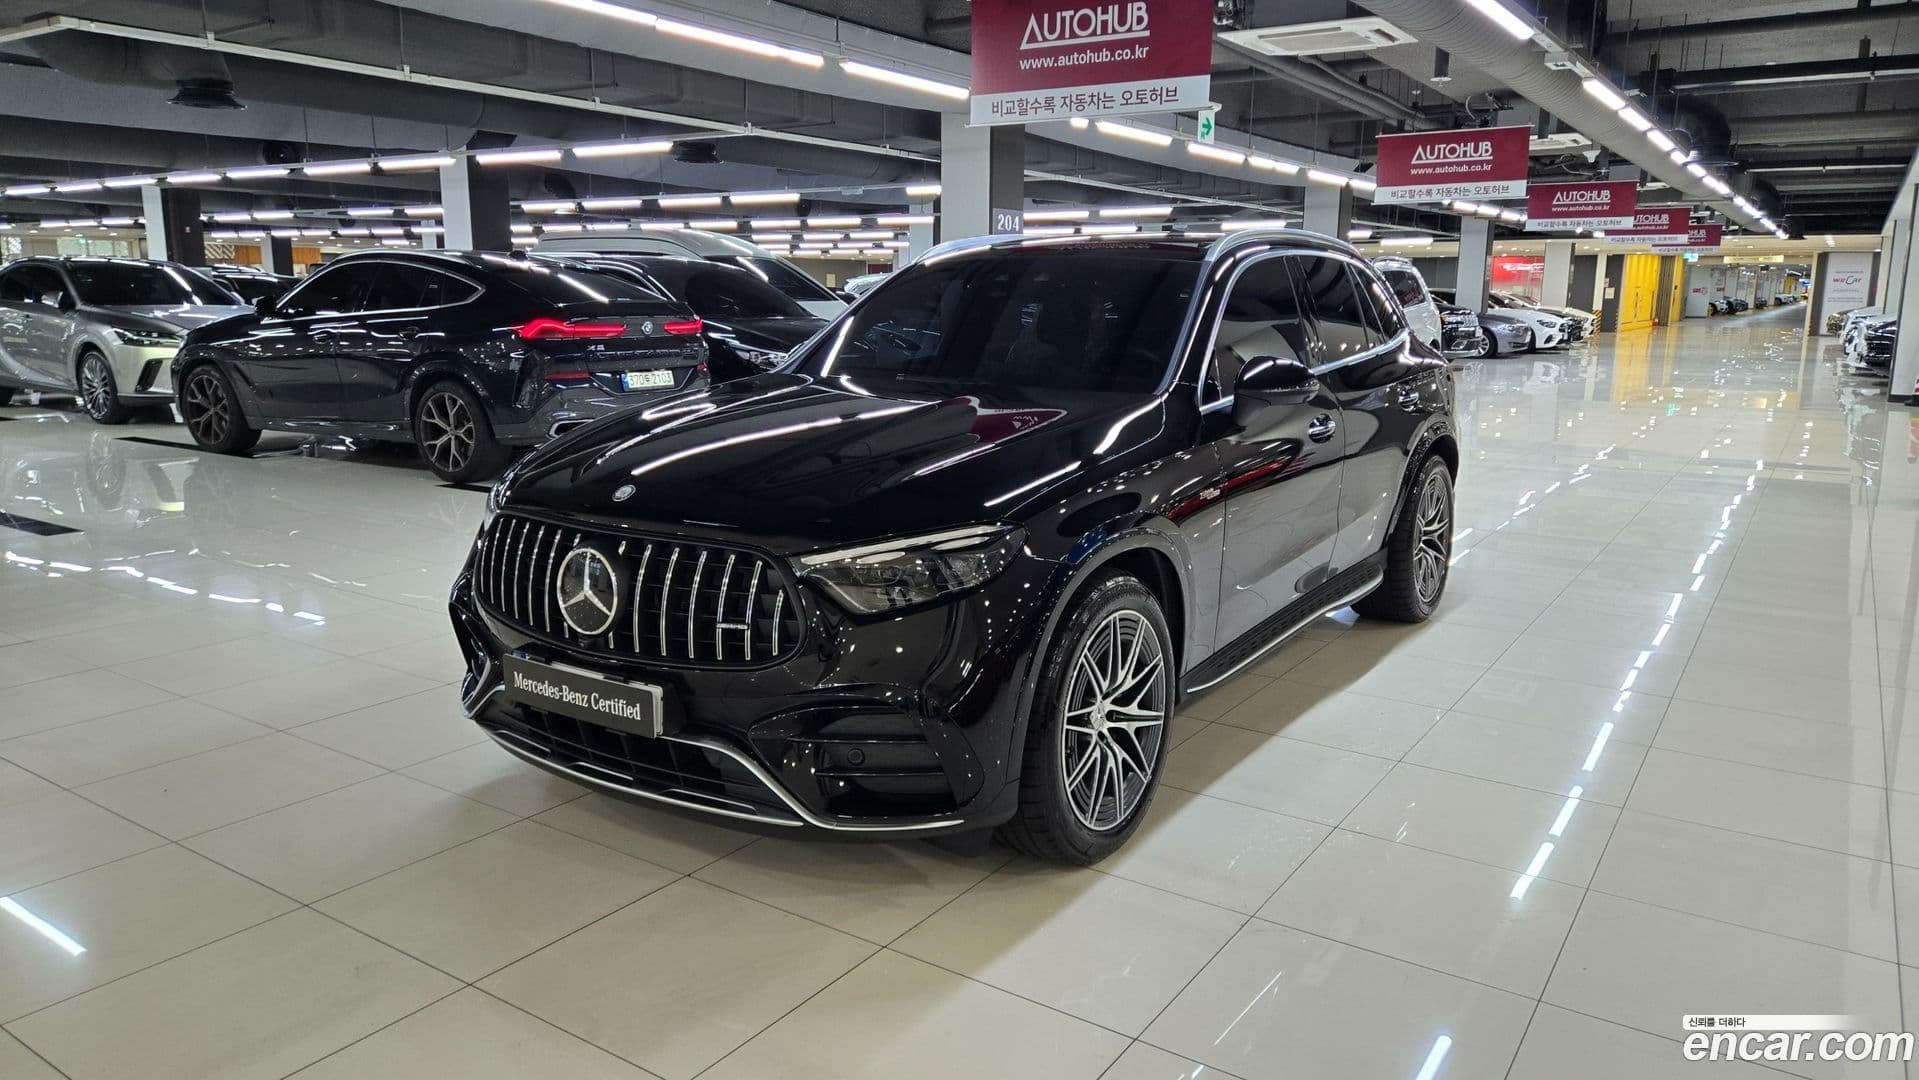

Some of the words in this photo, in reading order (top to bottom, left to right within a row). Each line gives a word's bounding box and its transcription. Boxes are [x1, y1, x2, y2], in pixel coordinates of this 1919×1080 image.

[1020, 1, 1150, 50] AUTOHUB
[1019, 45, 1150, 70] www.autohub.co.kr
[991, 96, 1056, 117] 비교할수록
[1060, 92, 1116, 112] 자동차는
[1120, 86, 1179, 107] 오토허브
[1411, 141, 1493, 164] AUTOHUB
[1410, 163, 1492, 175] www.autohub.co.kr
[1391, 188, 1433, 199] 비교할수록
[1435, 186, 1471, 197] 자동차는
[1473, 184, 1510, 195] 오토허브
[1552, 190, 1611, 204] AUTOHUB
[997, 213, 1020, 231] 204
[1634, 214, 1670, 224] UTOHUB
[513, 671, 589, 708] Mercedes-Benz
[591, 692, 641, 721] Certified
